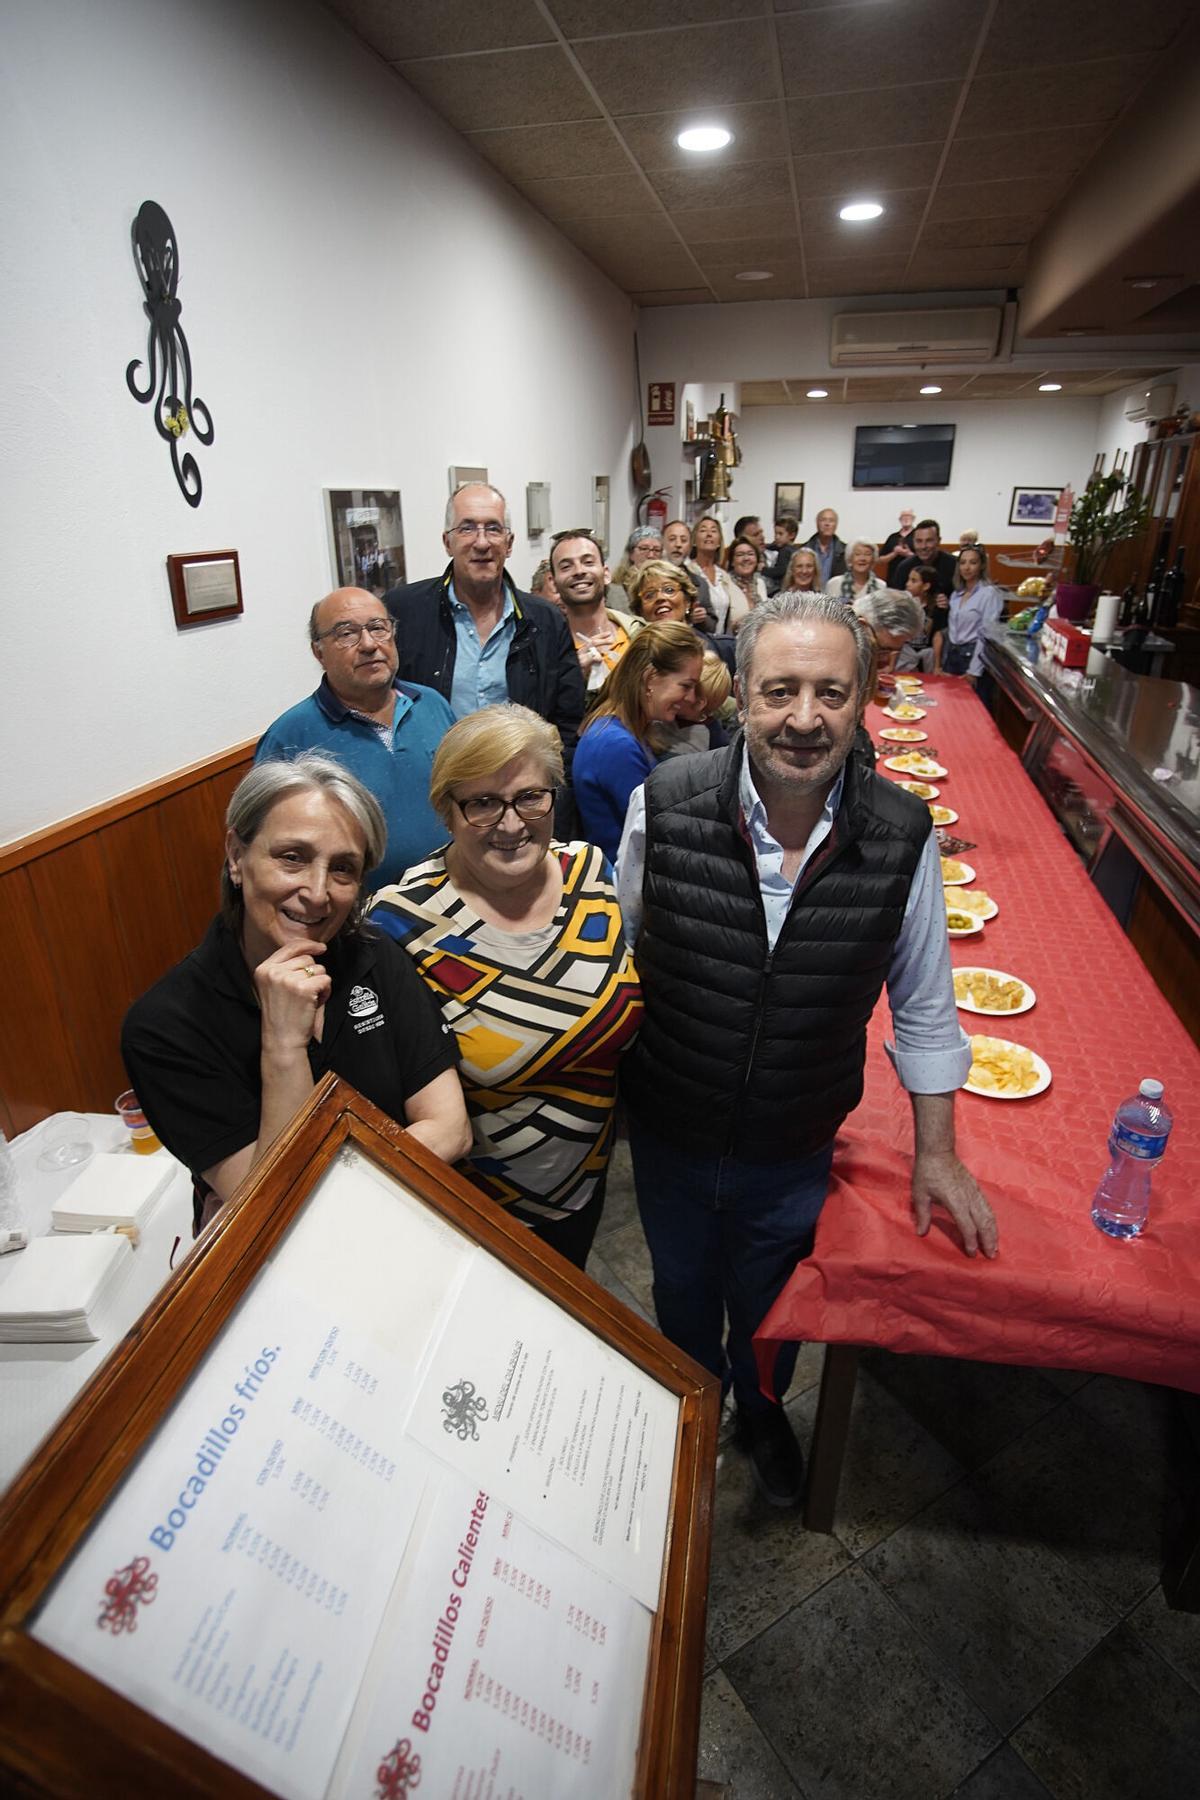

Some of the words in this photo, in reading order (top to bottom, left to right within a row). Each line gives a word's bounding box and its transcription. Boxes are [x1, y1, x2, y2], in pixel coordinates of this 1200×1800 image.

[149, 1403, 246, 1552] Bocadillos
[235, 1345, 281, 1402] fríos.
[412, 1593, 462, 1732] Bocadillos
